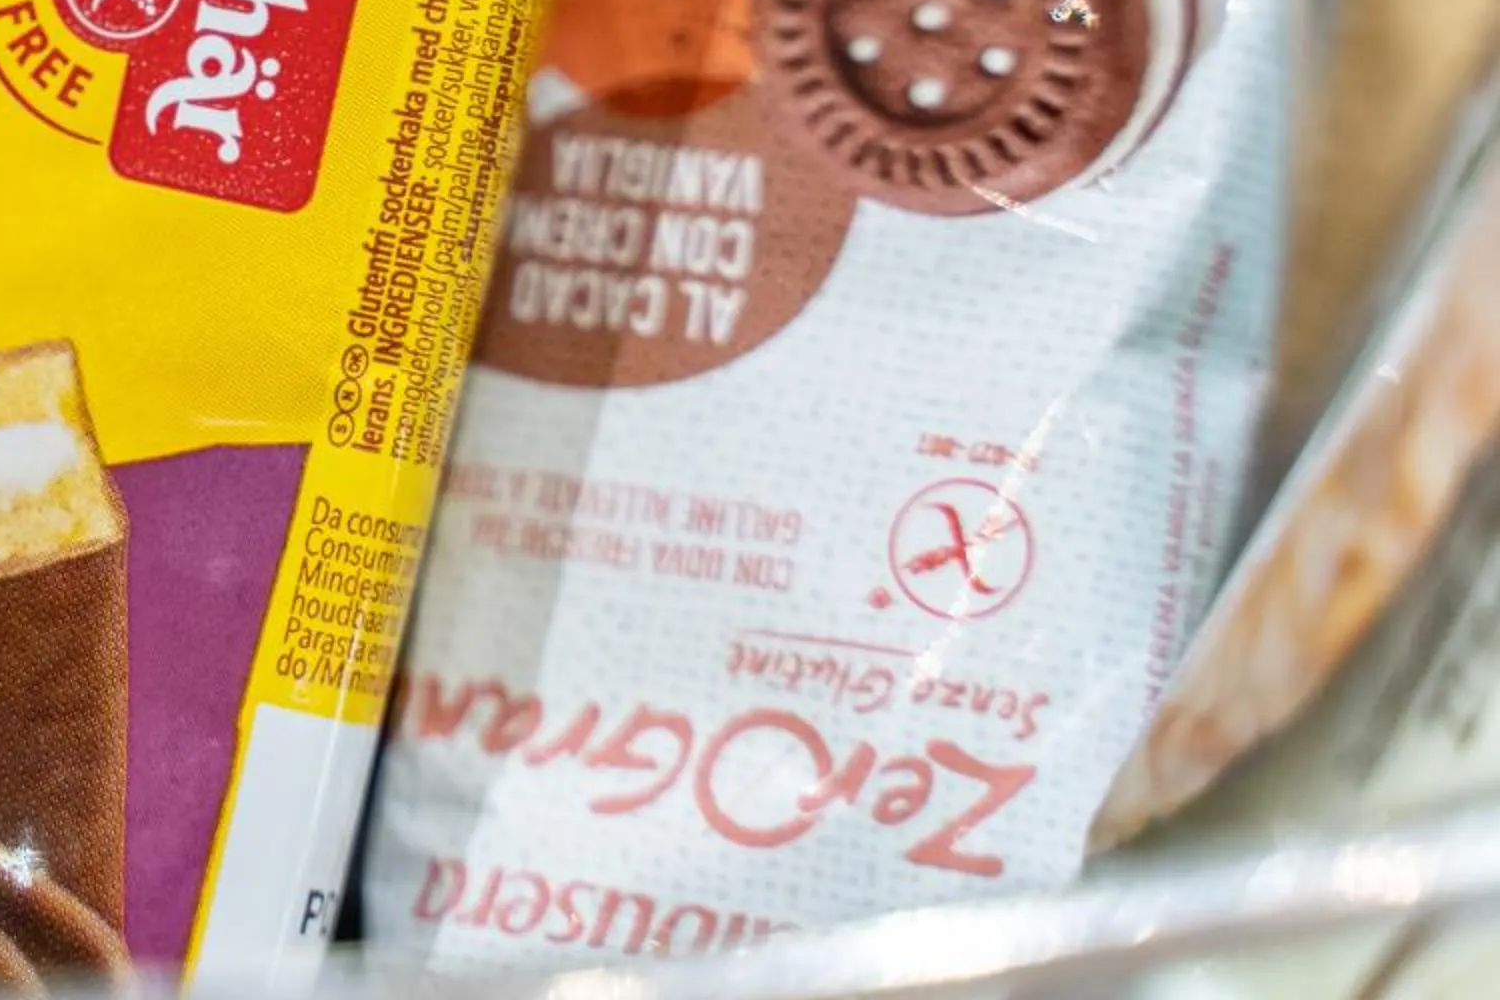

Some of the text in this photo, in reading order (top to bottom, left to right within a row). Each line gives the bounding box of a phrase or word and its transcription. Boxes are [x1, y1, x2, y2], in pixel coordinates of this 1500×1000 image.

[399, 26, 442, 86] med
[414, 12, 477, 172] socker/sukker,
[369, 86, 427, 226] sockerkaka
[547, 131, 766, 214] VANIGLIA
[372, 173, 441, 368] INGREDIENSER:
[507, 192, 754, 281] CON CREM
[343, 226, 399, 339] Glutenfri
[508, 260, 747, 346] AL CACAO
[350, 367, 399, 454] lerans.
[380, 275, 451, 461] mængdeforhold
[309, 495, 344, 530] Da
[726, 641, 897, 714] Glutine
